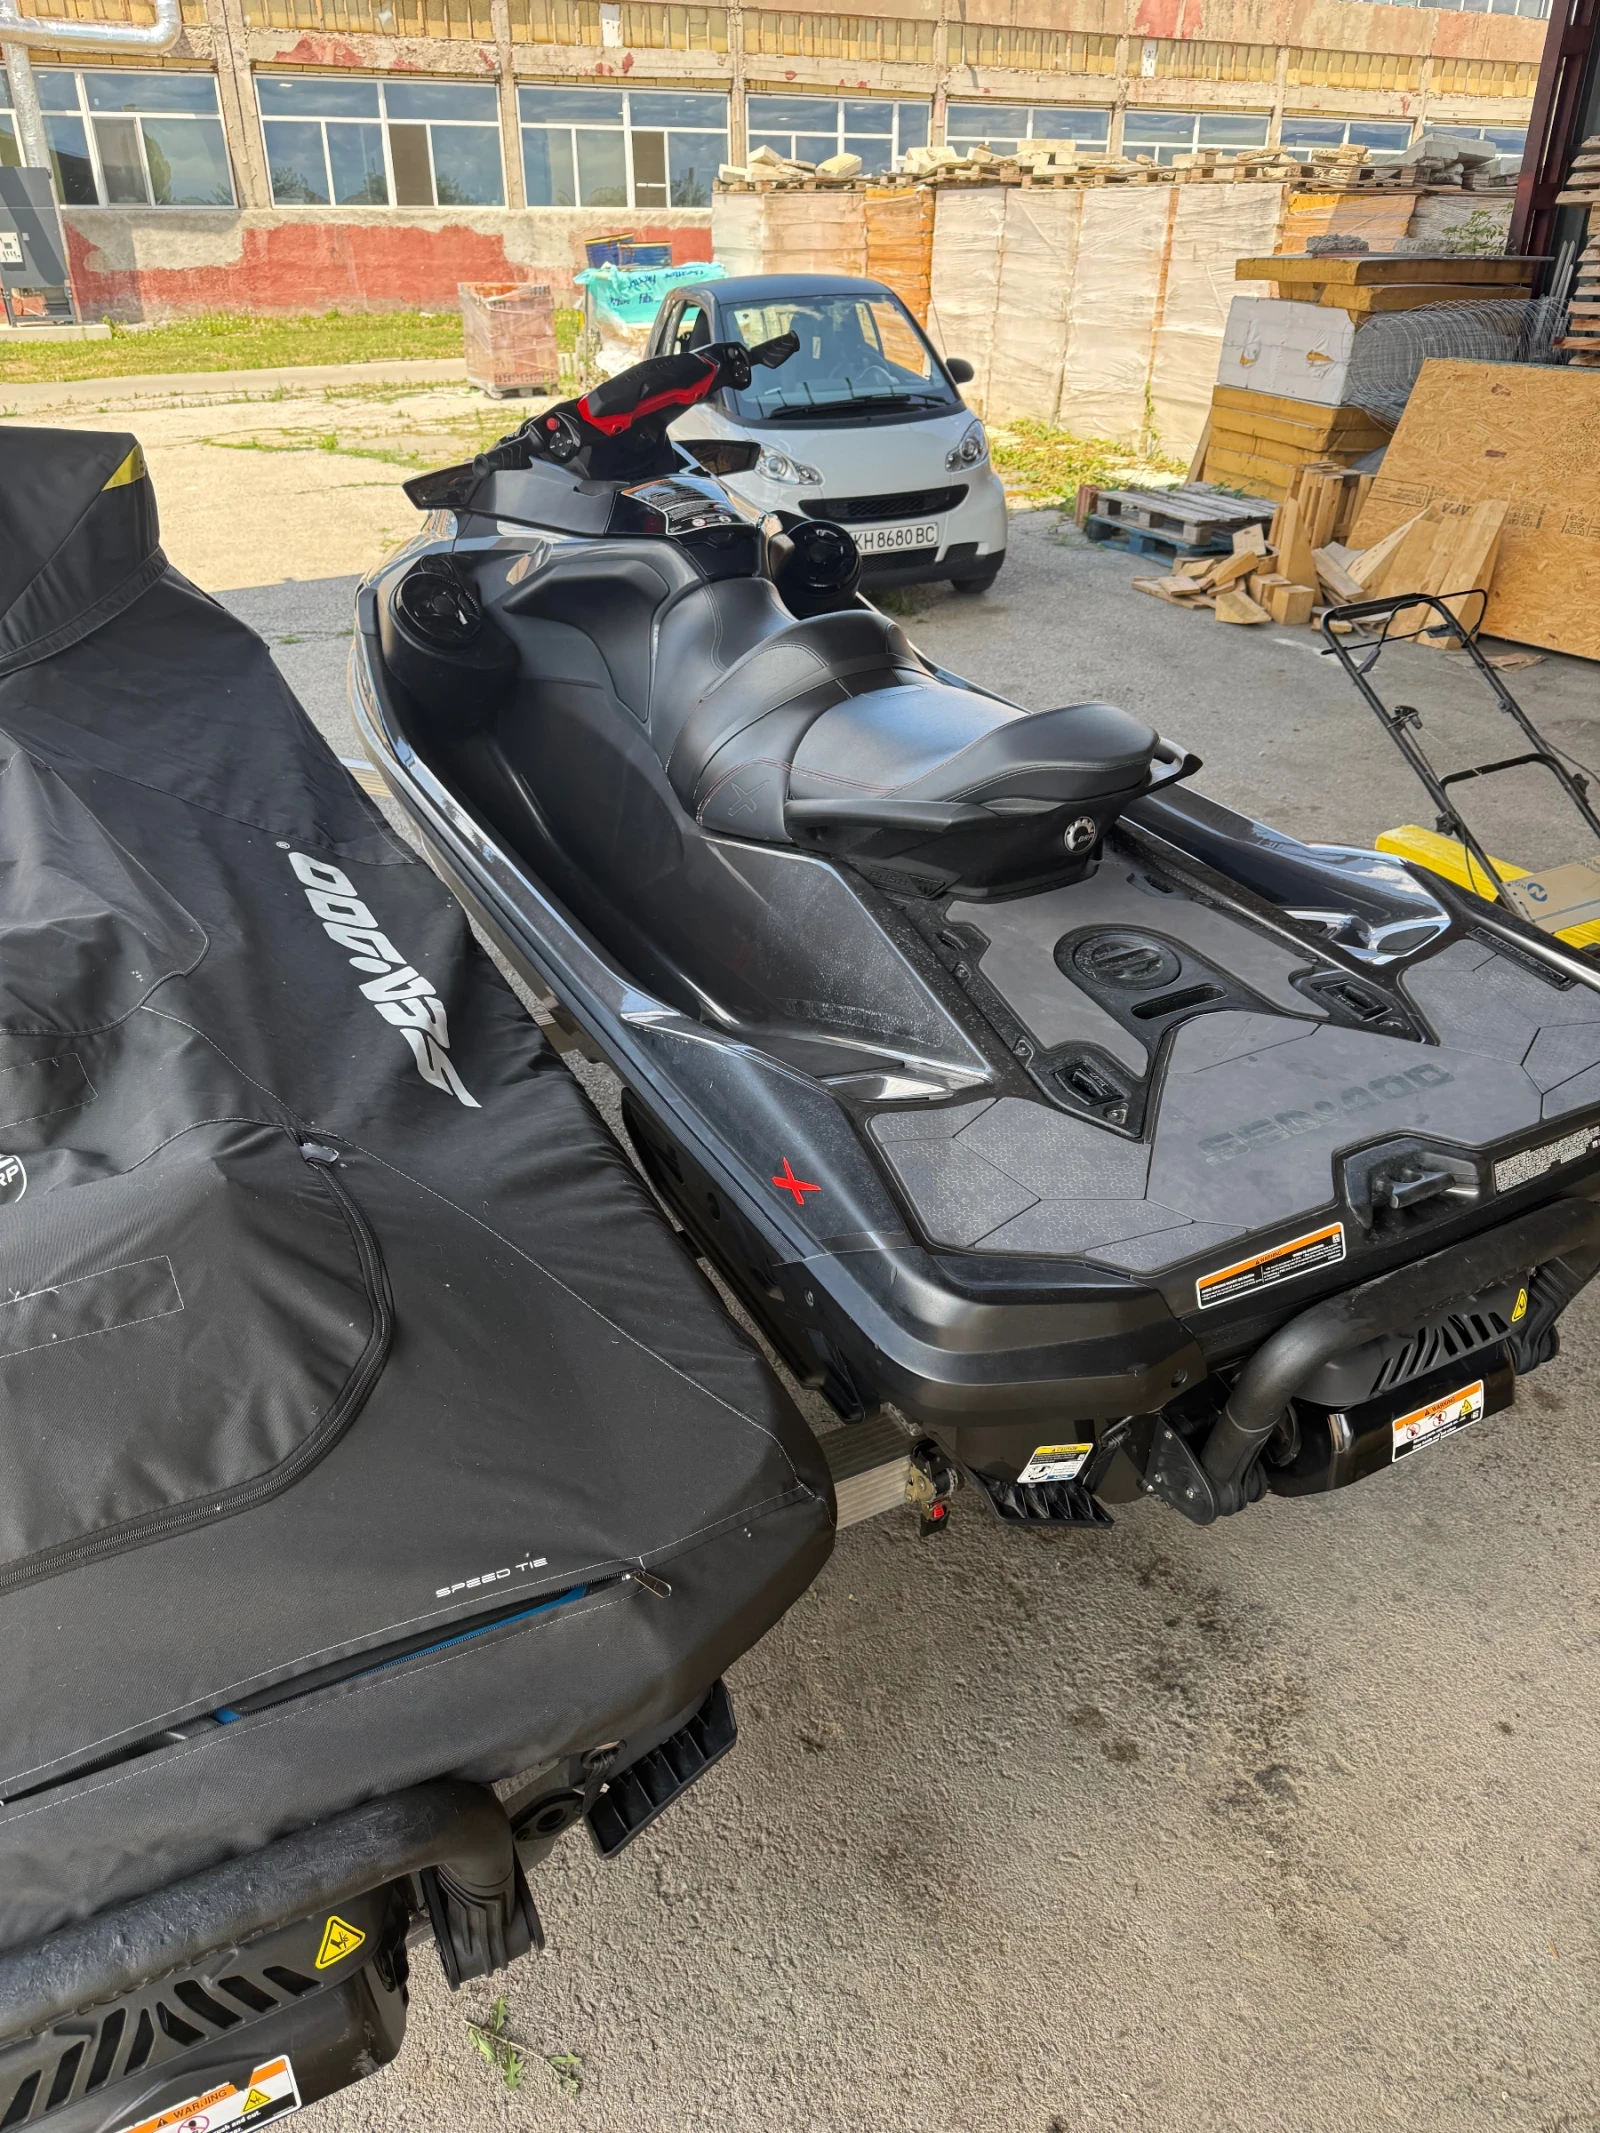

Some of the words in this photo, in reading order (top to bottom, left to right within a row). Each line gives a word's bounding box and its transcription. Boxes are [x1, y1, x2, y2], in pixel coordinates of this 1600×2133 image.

[854, 532, 874, 550] KH
[877, 529, 913, 548] 8680
[916, 526, 935, 544] BC
[869, 871, 908, 886] PUSH
[435, 1568, 511, 1598] SPEED
[515, 1557, 549, 1572] TIE
[173, 2089, 228, 2120] WARNING
[231, 2116, 246, 2128] and
[246, 2110, 262, 2121] cut.
